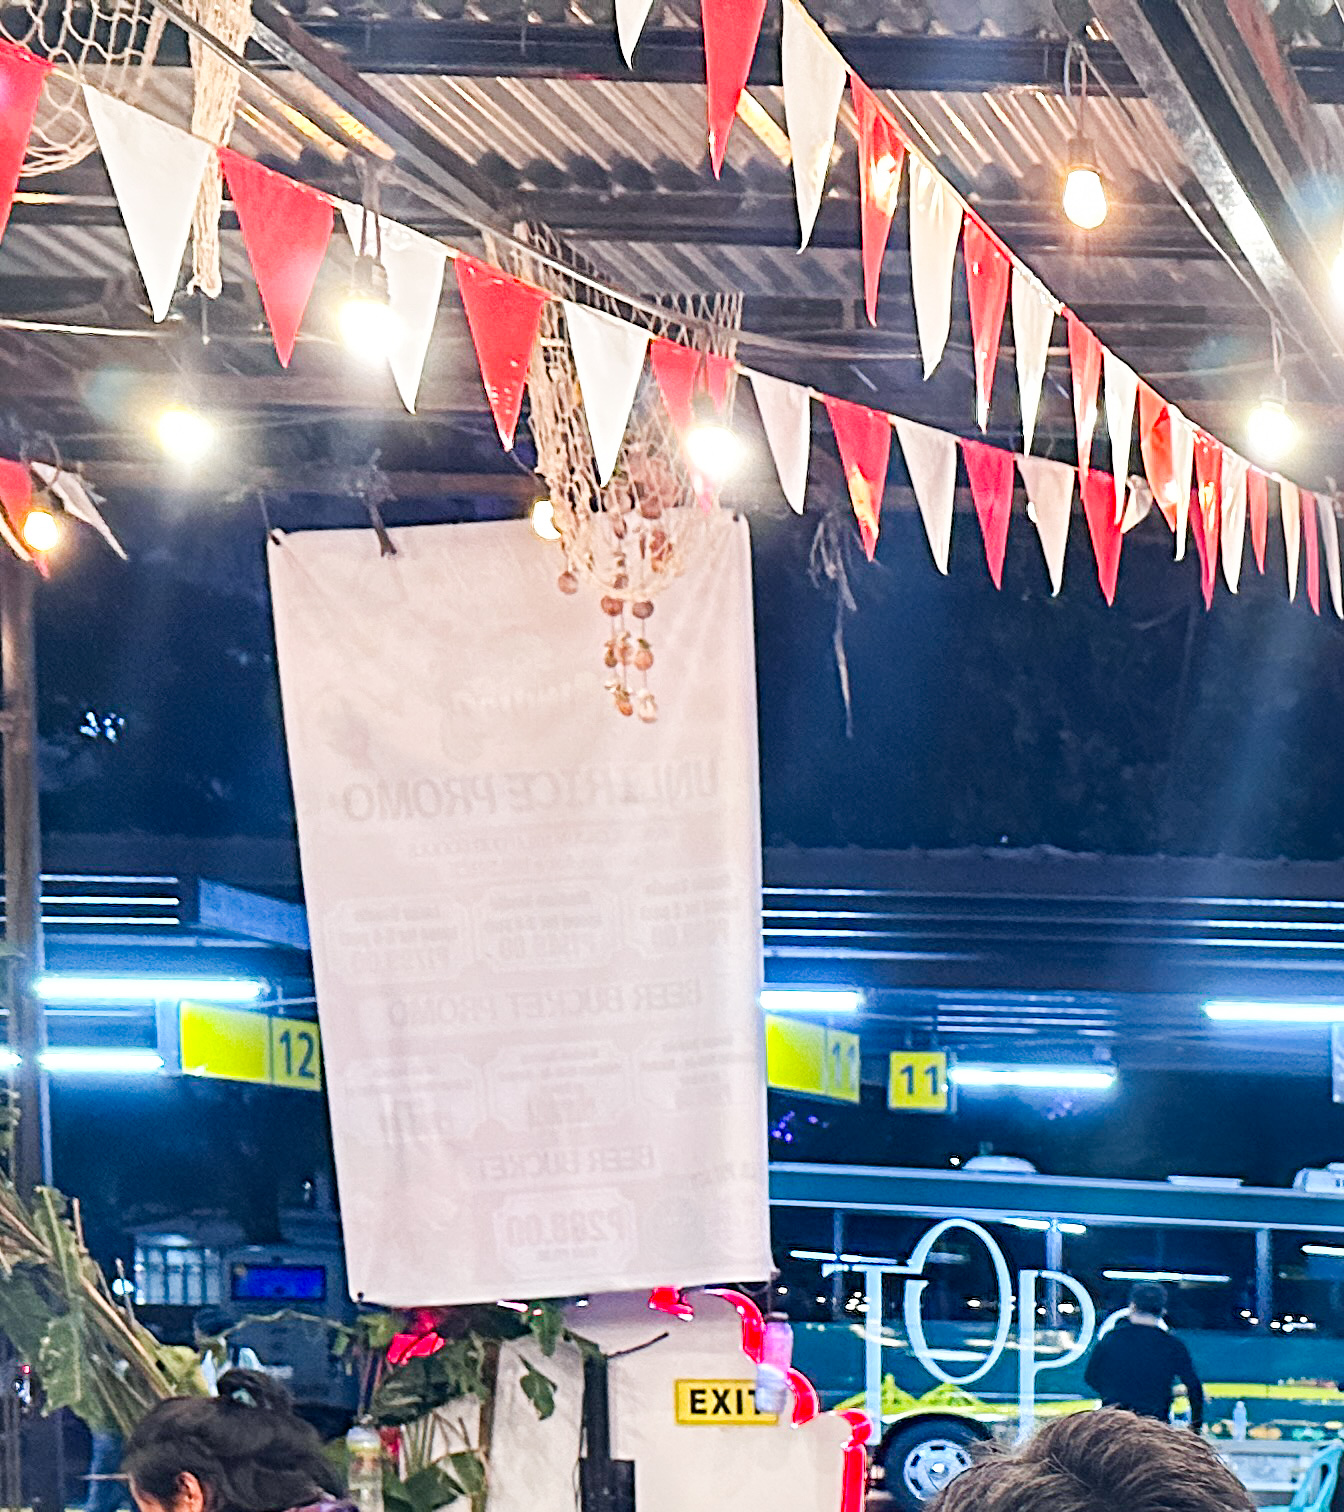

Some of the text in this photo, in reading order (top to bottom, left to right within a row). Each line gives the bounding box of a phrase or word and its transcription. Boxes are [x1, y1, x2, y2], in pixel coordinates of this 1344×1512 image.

[279, 1029, 316, 1079] 12
[900, 1065, 939, 1096] 11
[821, 1218, 1168, 1451] TOP
